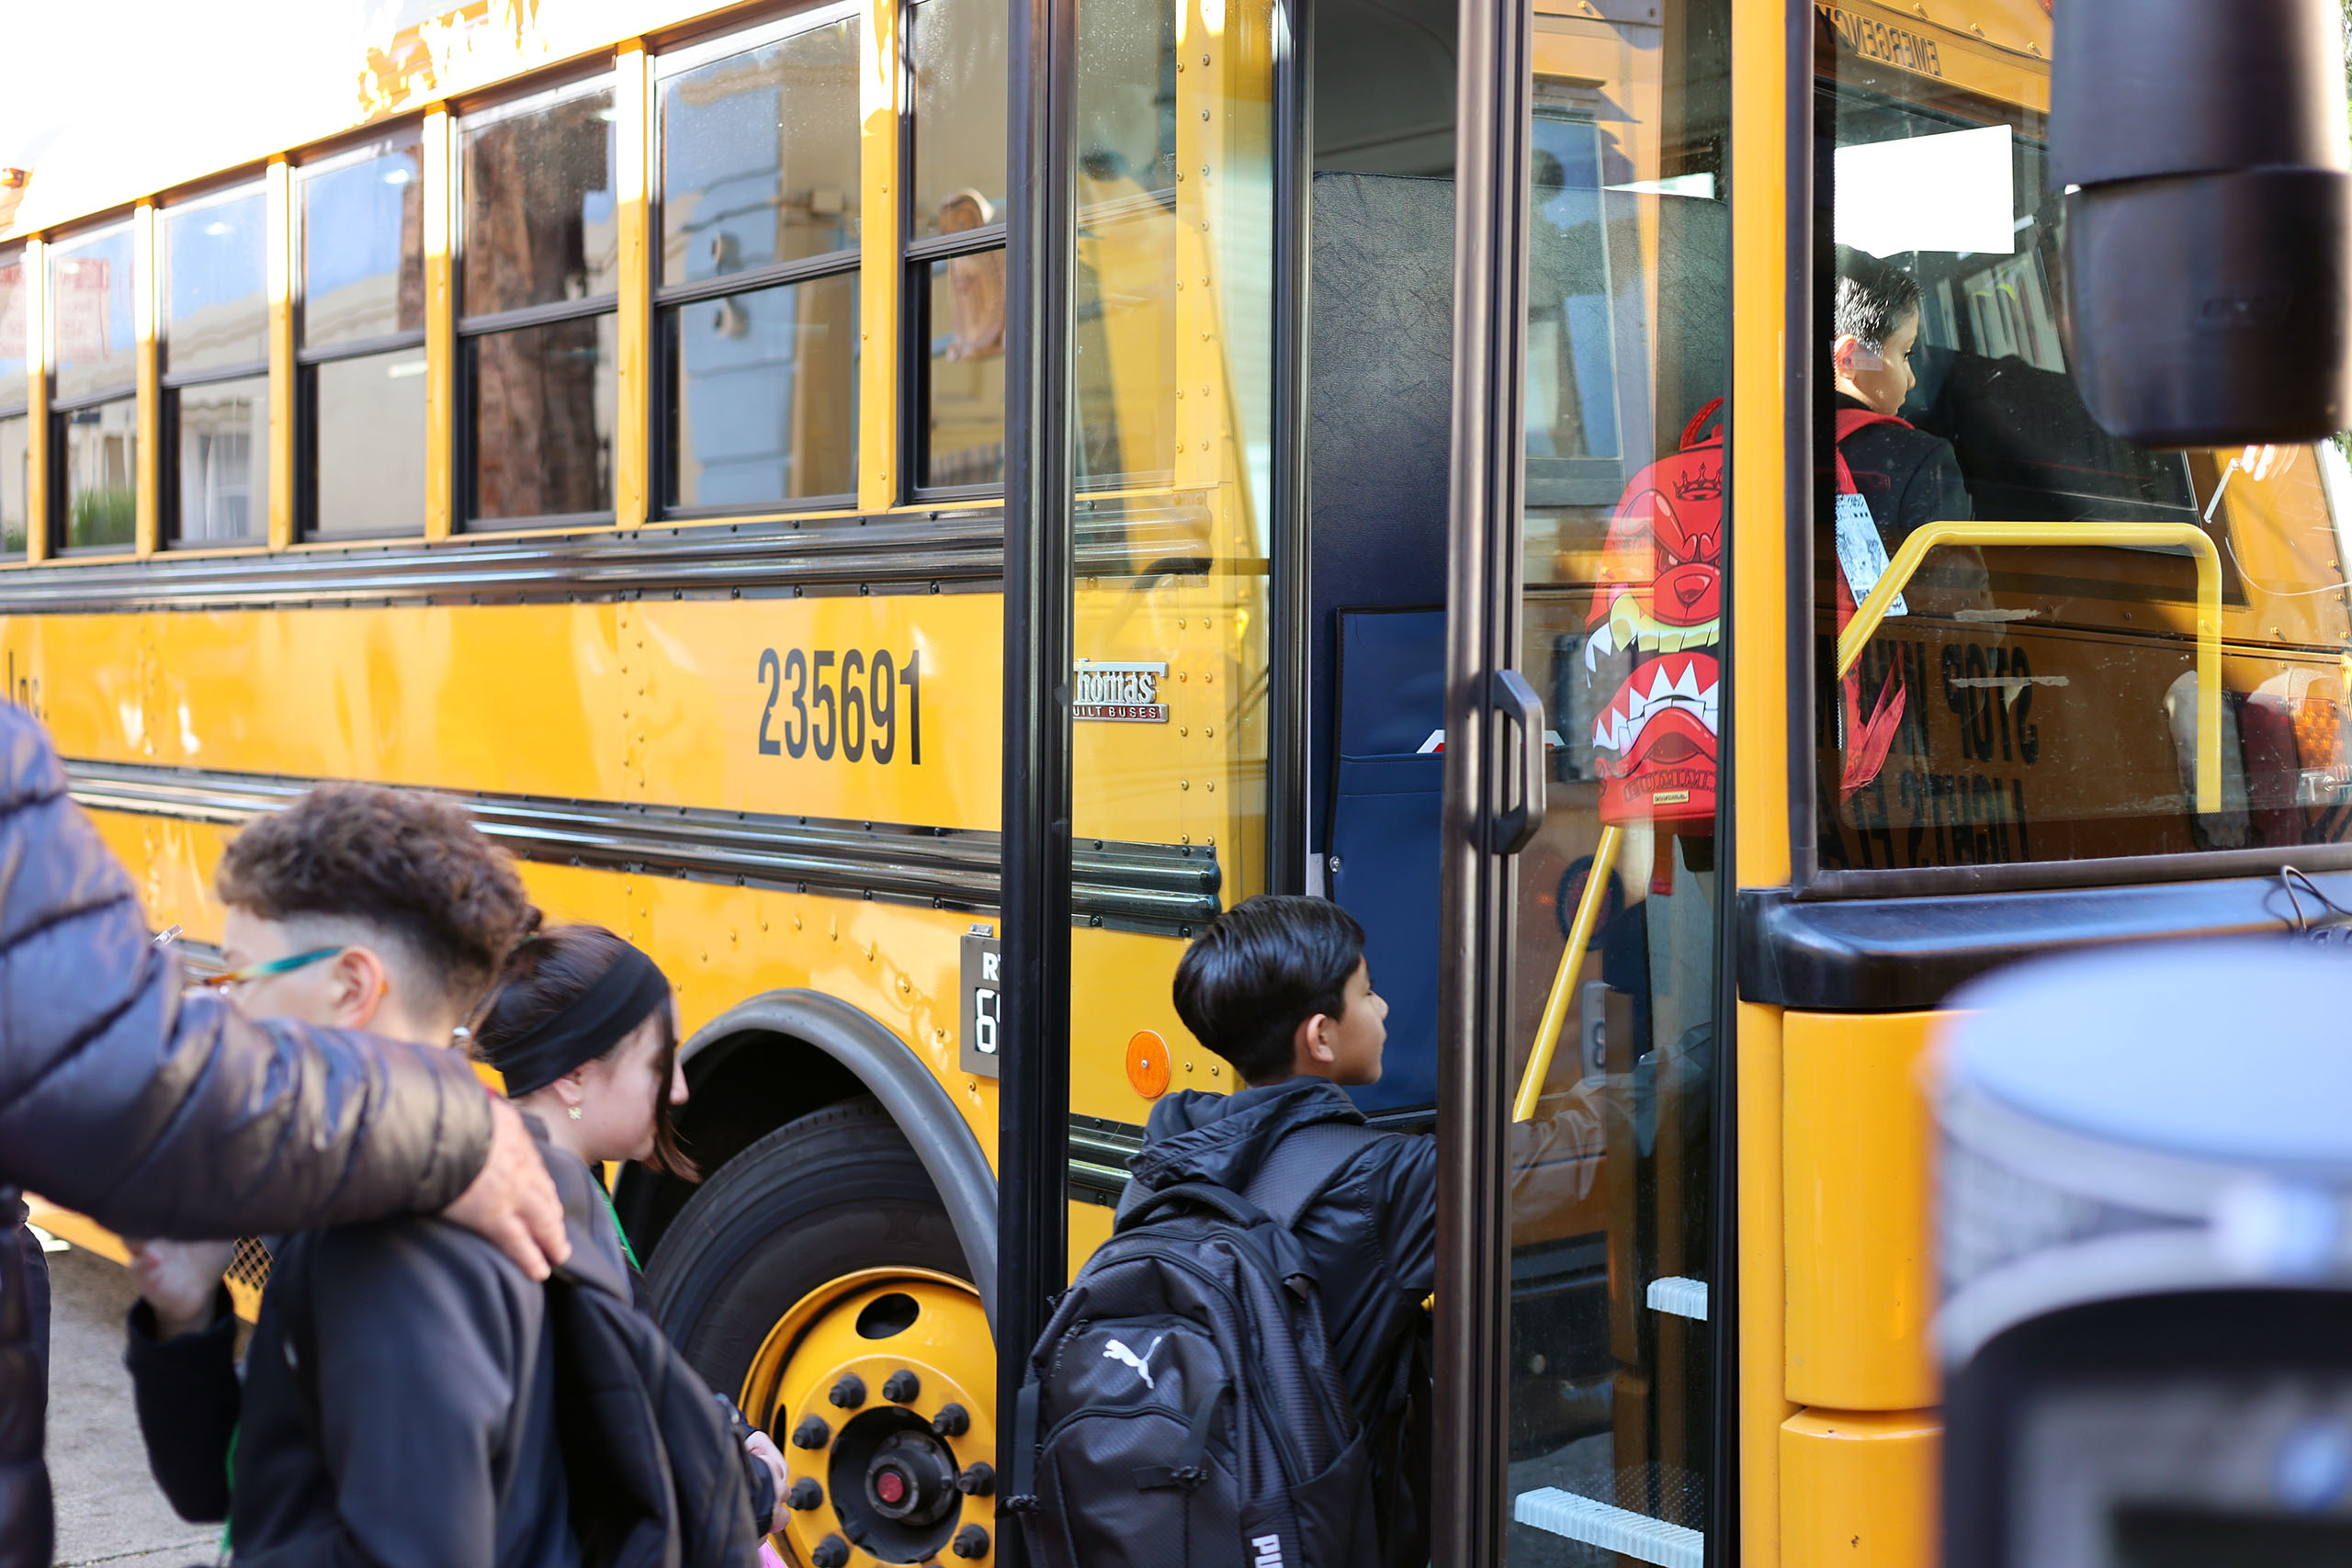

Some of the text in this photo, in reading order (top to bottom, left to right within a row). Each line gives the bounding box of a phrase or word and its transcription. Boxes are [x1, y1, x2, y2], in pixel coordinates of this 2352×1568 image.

[758, 648, 921, 765] 235691
[1073, 705, 1157, 718] UILT BUSES
[982, 952, 1001, 981] R
[976, 988, 1001, 1054] 6
